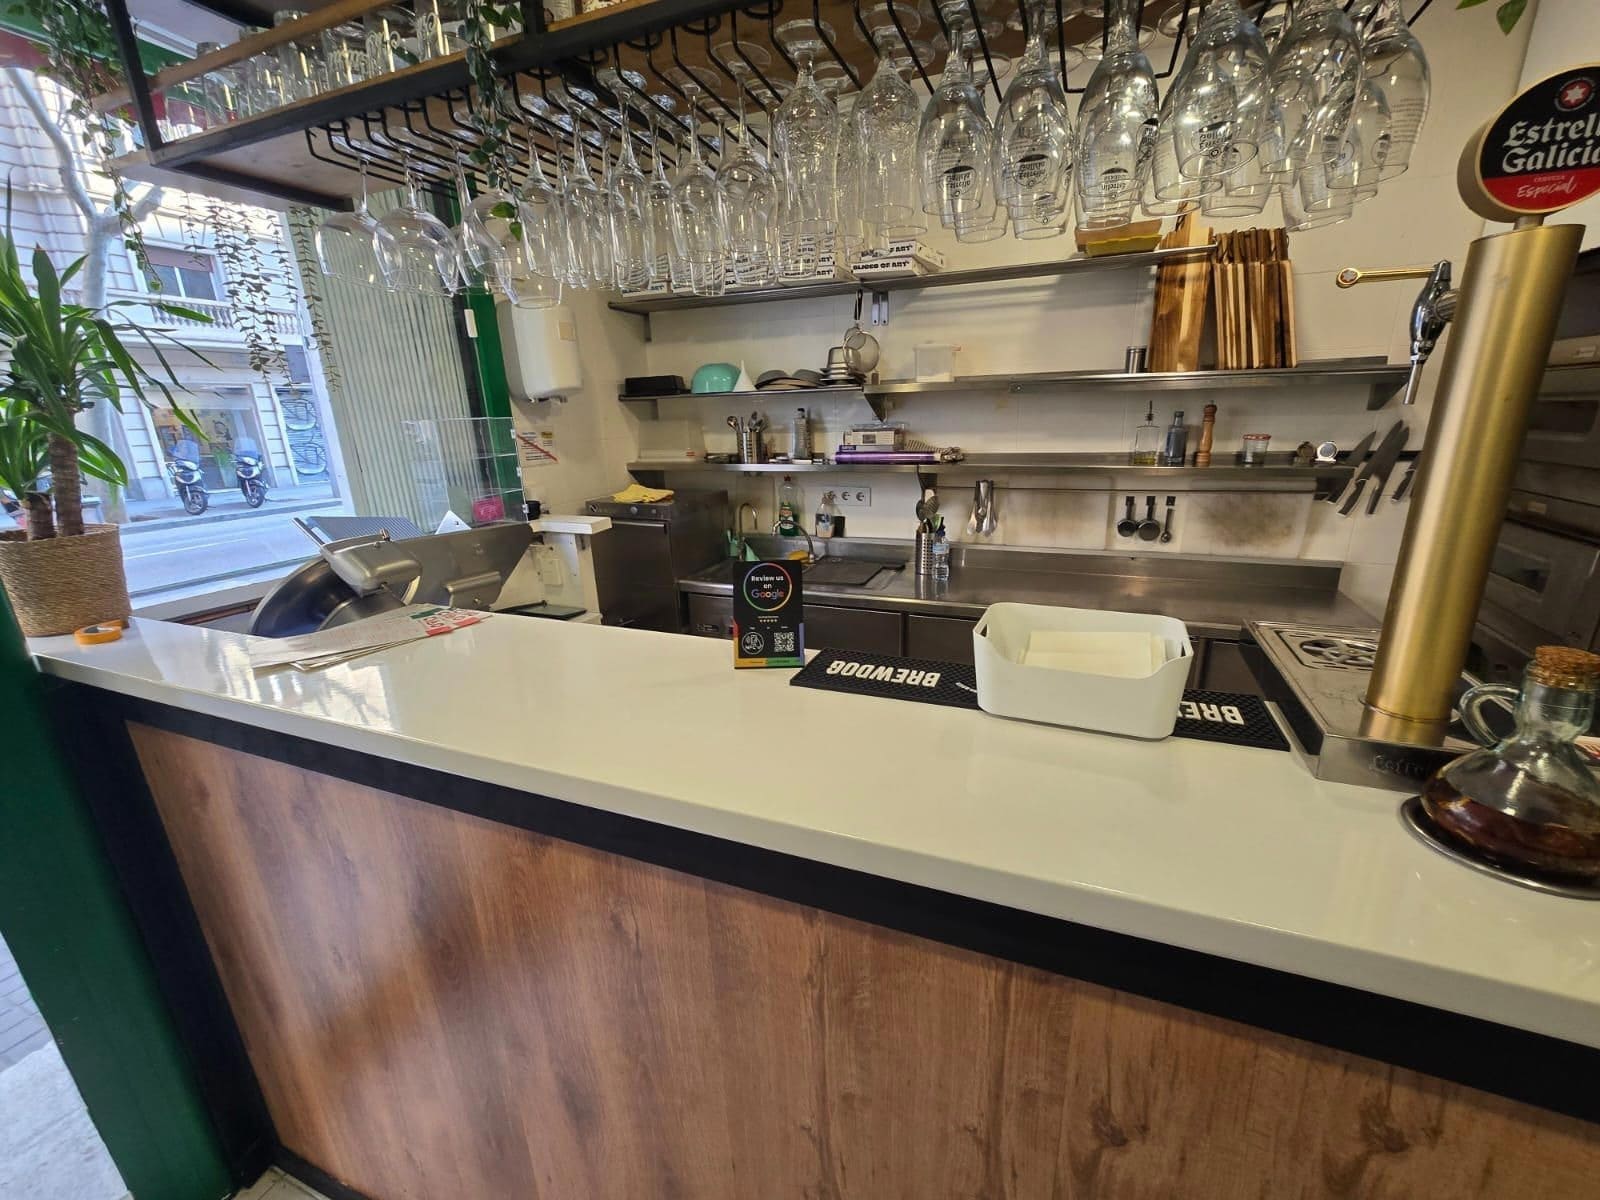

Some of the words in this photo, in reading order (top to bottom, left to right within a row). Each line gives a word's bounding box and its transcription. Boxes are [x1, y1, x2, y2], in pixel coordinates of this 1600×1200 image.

[1516, 175, 1577, 198] Especial
[891, 261, 910, 269] ART
[751, 588, 785, 601] Google
[826, 660, 941, 688] BREWDOG
